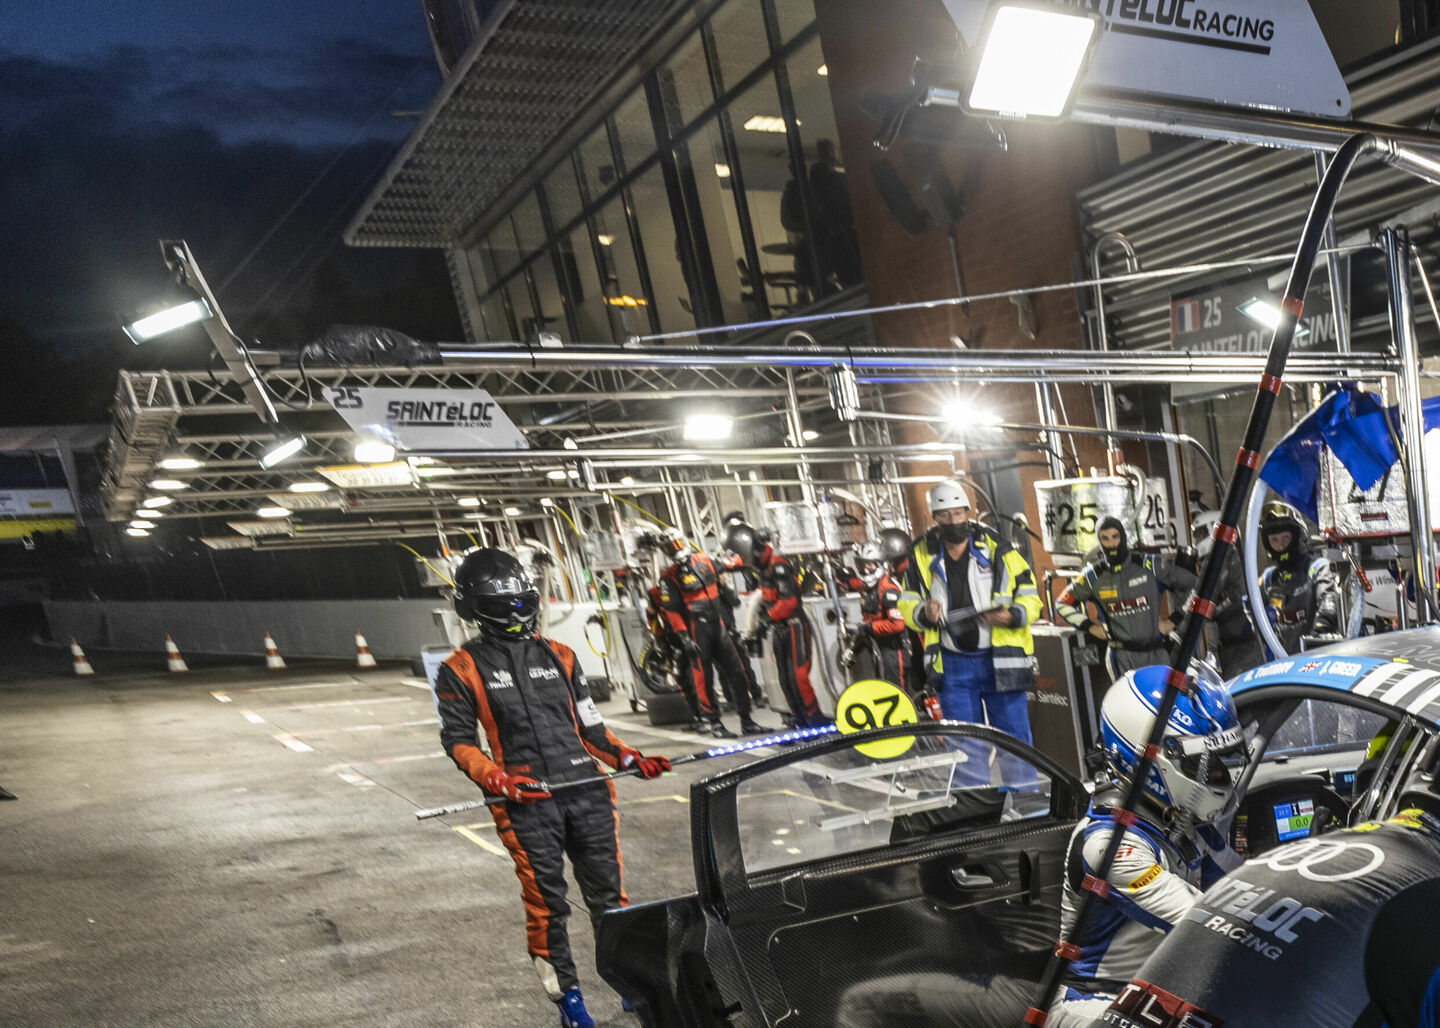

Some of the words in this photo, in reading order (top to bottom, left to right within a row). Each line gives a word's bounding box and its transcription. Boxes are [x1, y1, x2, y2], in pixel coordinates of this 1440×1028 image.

[1193, 9, 1275, 42] RACING
[1203, 296, 1222, 329] 25
[331, 387, 363, 409] 25
[1045, 502, 1098, 537] #25
[1145, 494, 1165, 529] 26
[1203, 914, 1284, 961] RACING
